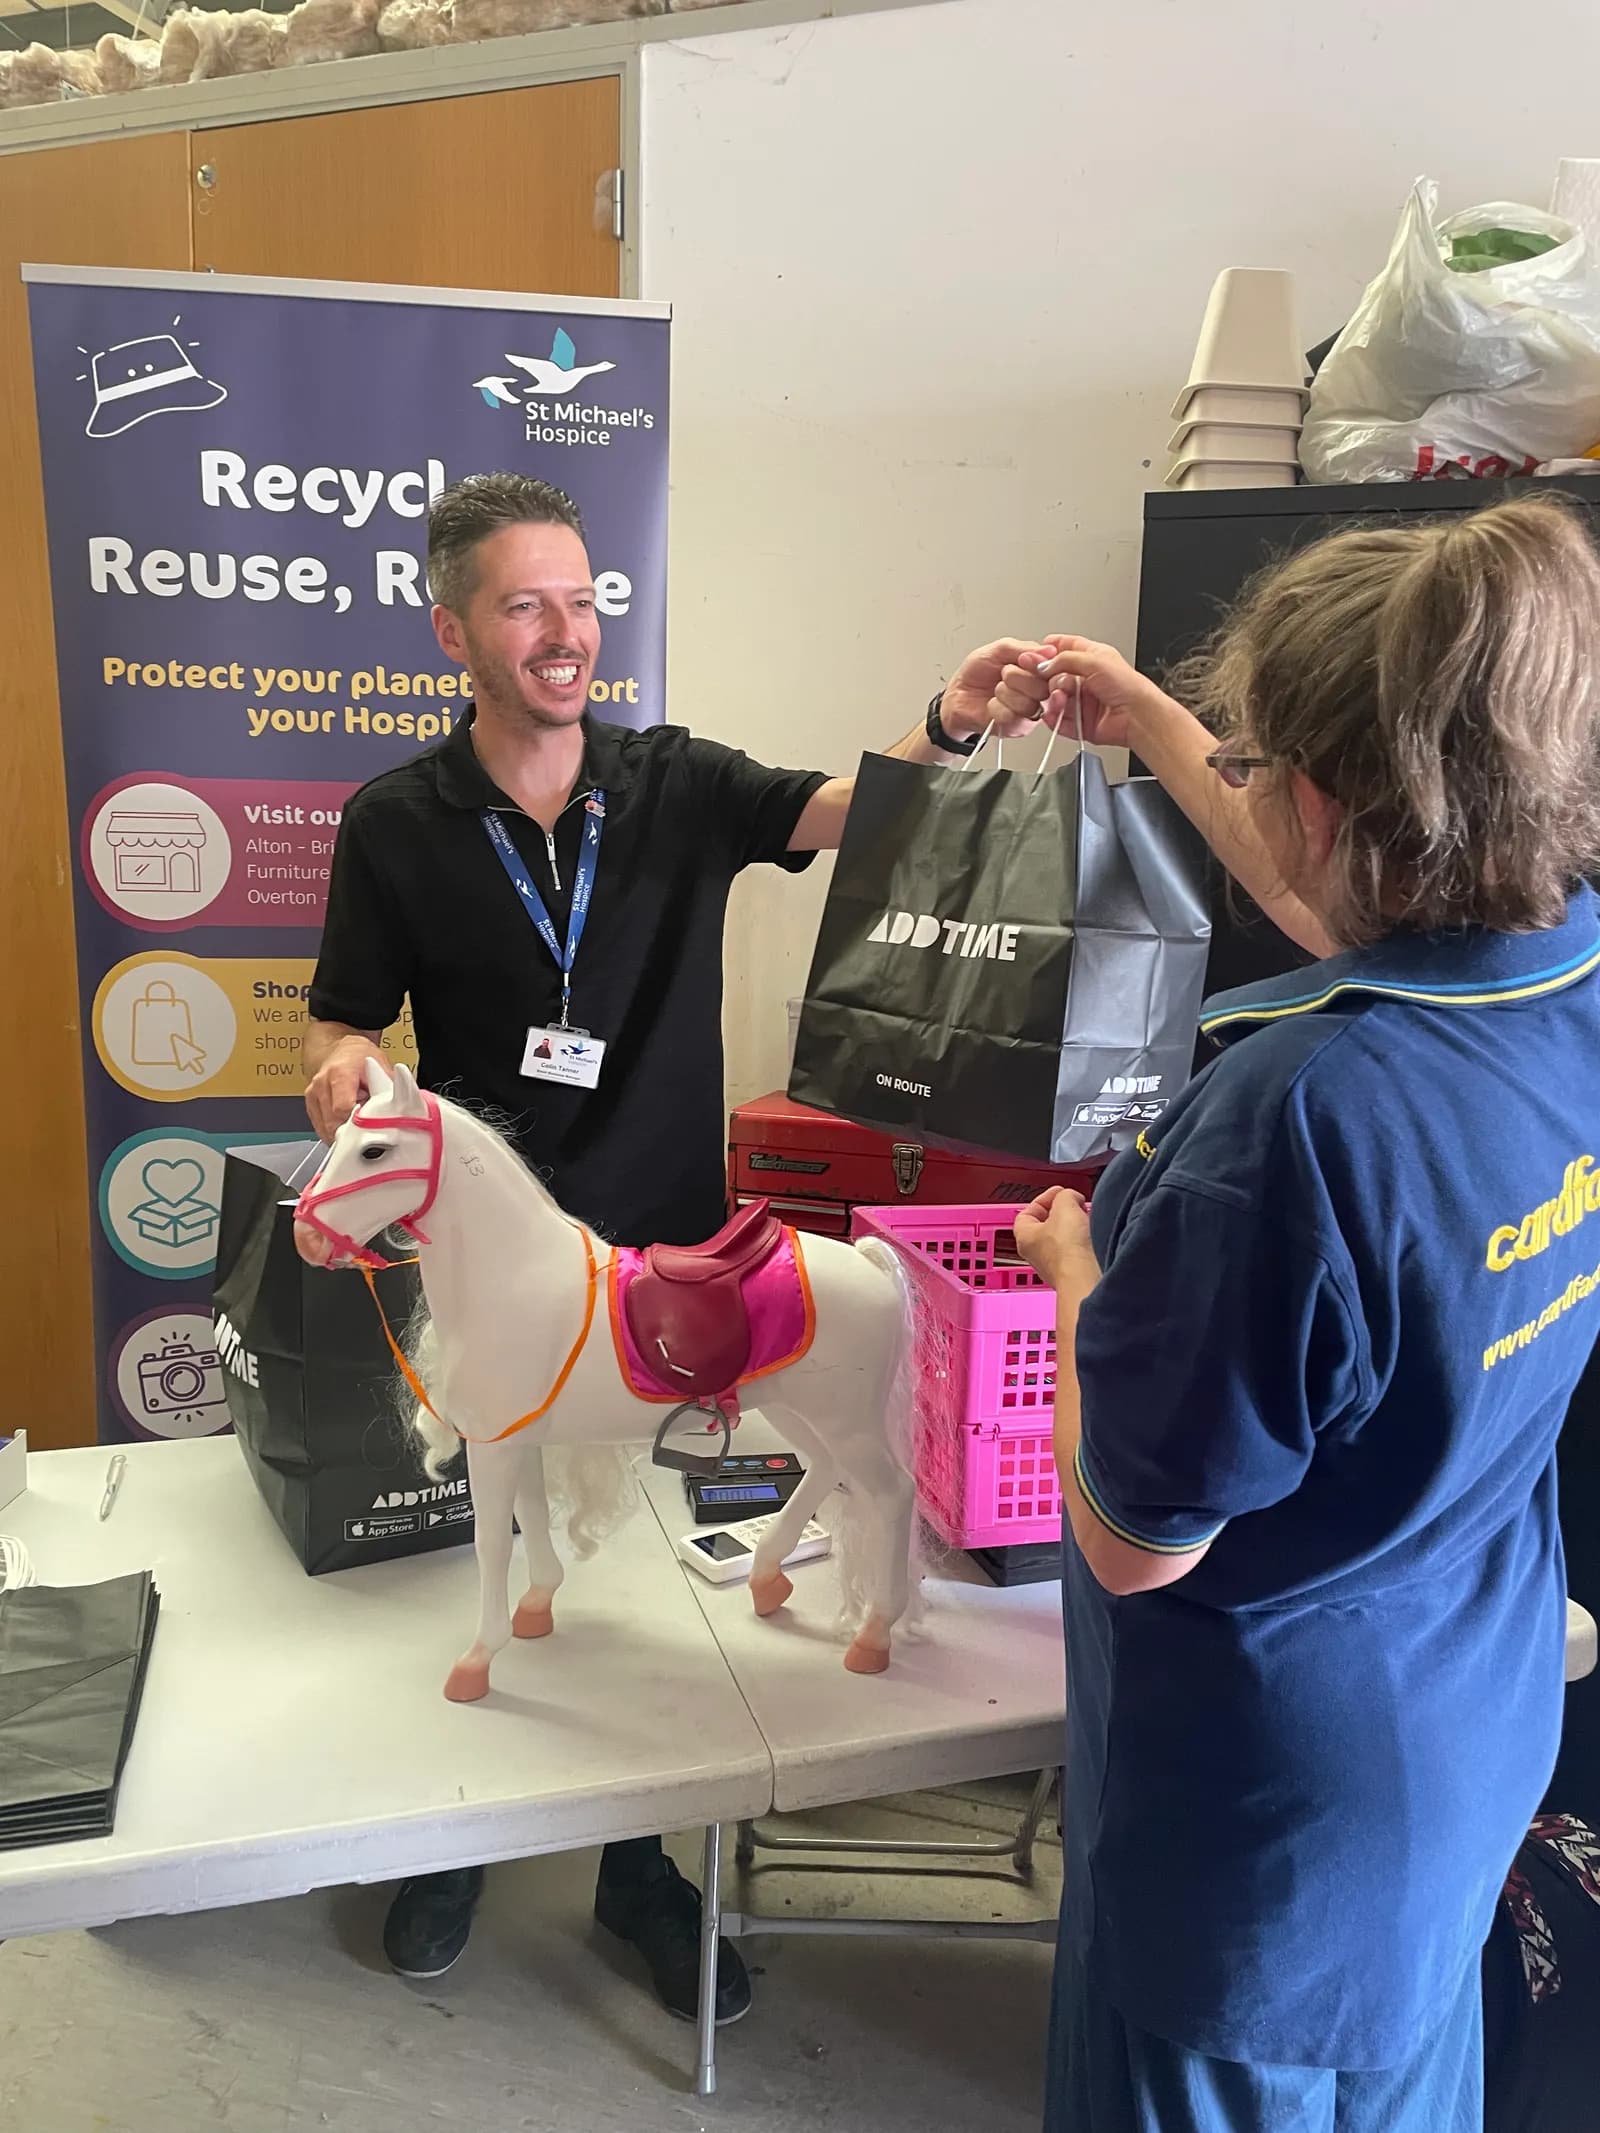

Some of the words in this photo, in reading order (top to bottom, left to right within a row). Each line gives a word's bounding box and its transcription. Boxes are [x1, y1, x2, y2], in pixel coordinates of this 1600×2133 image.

[526, 401, 549, 421] St
[554, 402, 655, 429] Michael's
[526, 424, 610, 446] Hospice
[201, 449, 445, 527] Recycl
[88, 537, 351, 614] Reuse,
[103, 656, 244, 692] Protect
[253, 667, 342, 697] your
[351, 666, 473, 700] planet
[246, 706, 336, 737] your
[345, 707, 458, 742] Hospi
[244, 804, 305, 825] Visit
[310, 810, 342, 826] ou
[246, 838, 292, 854] Alton
[312, 840, 335, 855] Bri
[247, 864, 331, 880] Furniture
[247, 889, 317, 905] Overton
[253, 1008, 283, 1023] We
[288, 1010, 313, 1023] ar
[255, 1033, 305, 1053] shop
[256, 1063, 294, 1076] now
[876, 1073, 893, 1088] ON
[894, 1077, 932, 1098] ROUTE
[1486, 1154, 1600, 1273] cardfa
[372, 1479, 468, 1509] ADDTIME
[368, 1527, 389, 1538] App
[389, 1522, 415, 1534] Store
